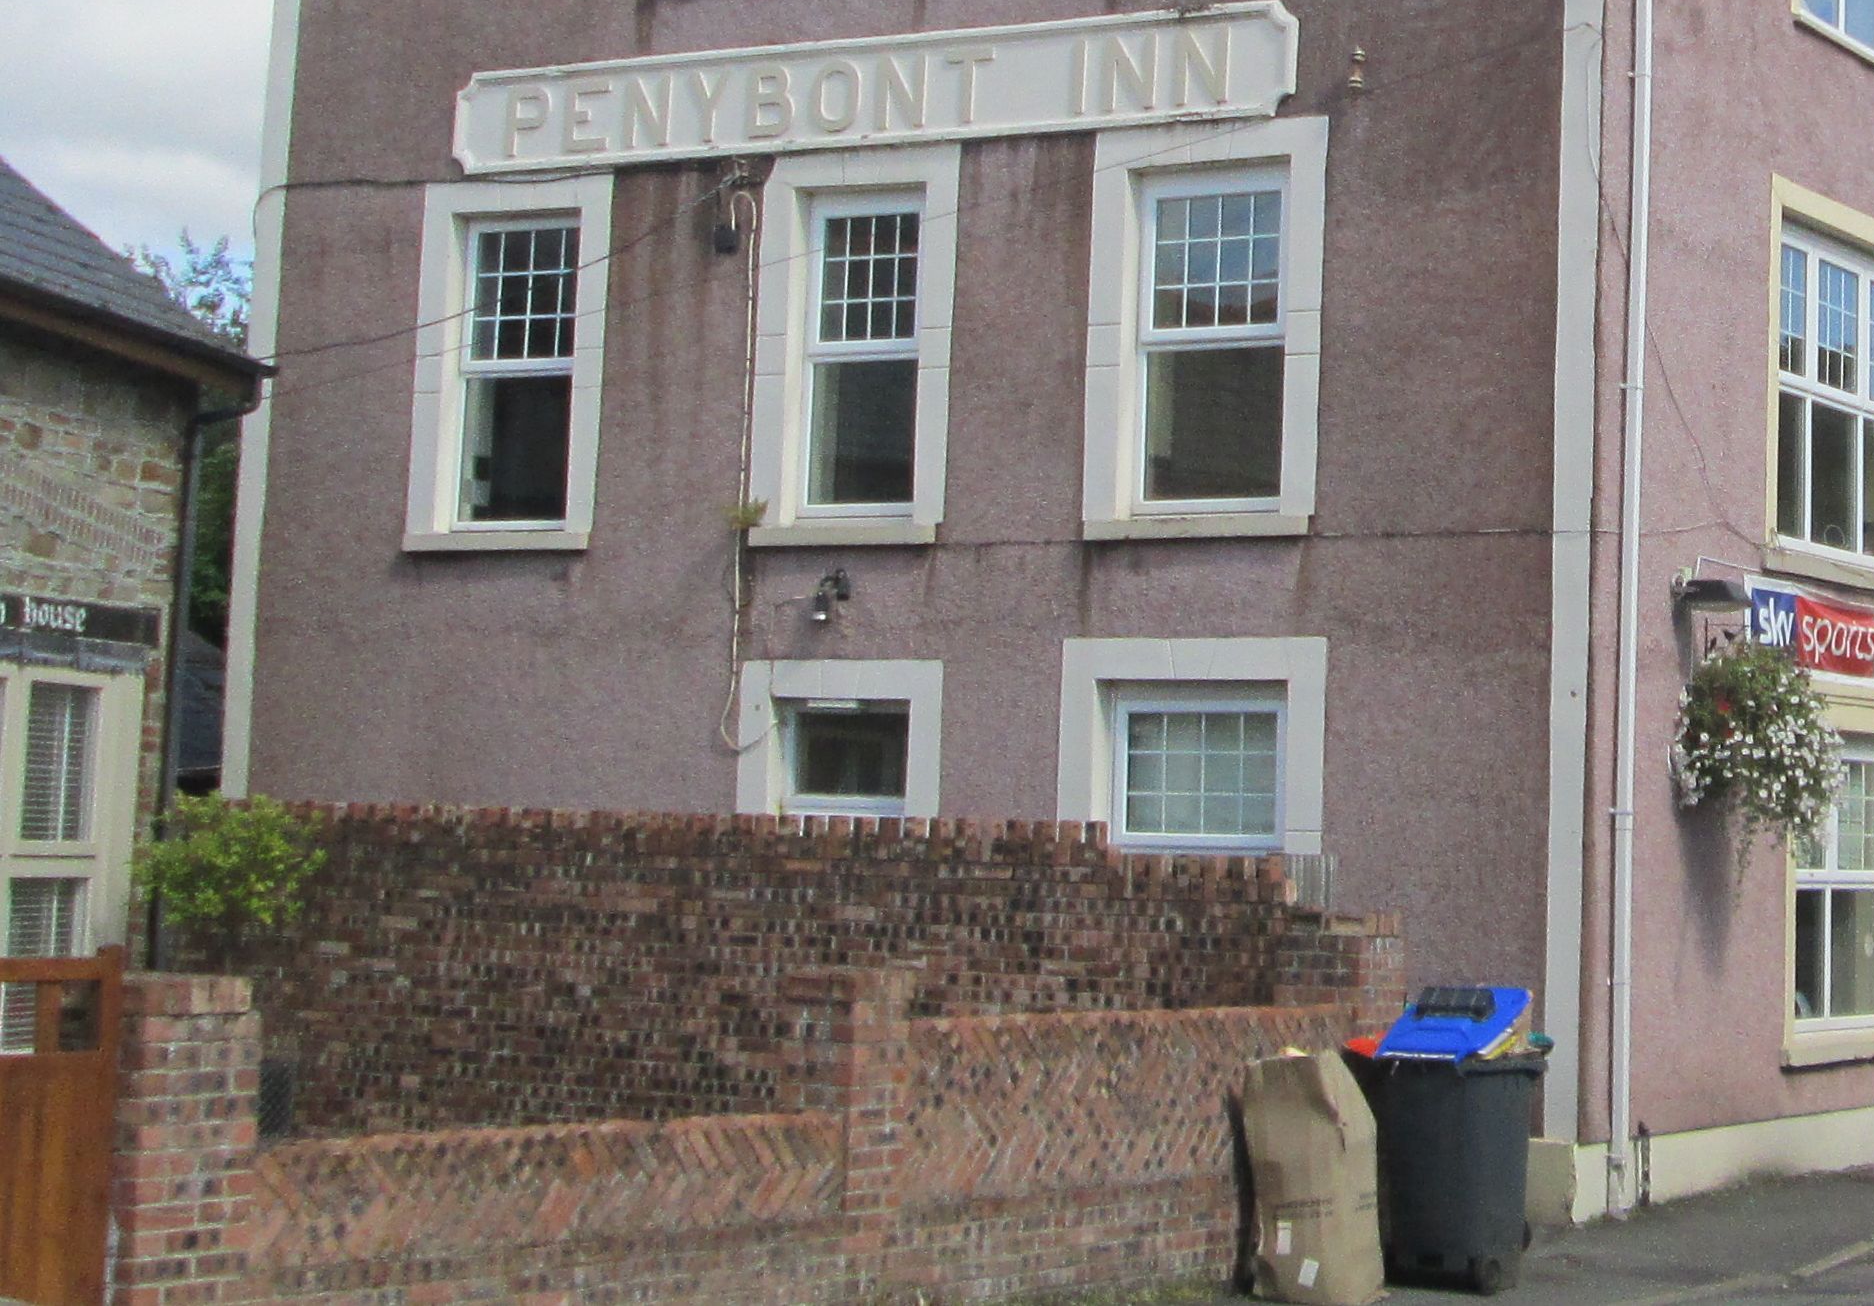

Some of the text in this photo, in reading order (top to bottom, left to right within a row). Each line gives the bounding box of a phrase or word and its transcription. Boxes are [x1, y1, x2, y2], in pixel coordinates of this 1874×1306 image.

[504, 24, 1234, 157] PENYBONT INN
[23, 596, 87, 633] house
